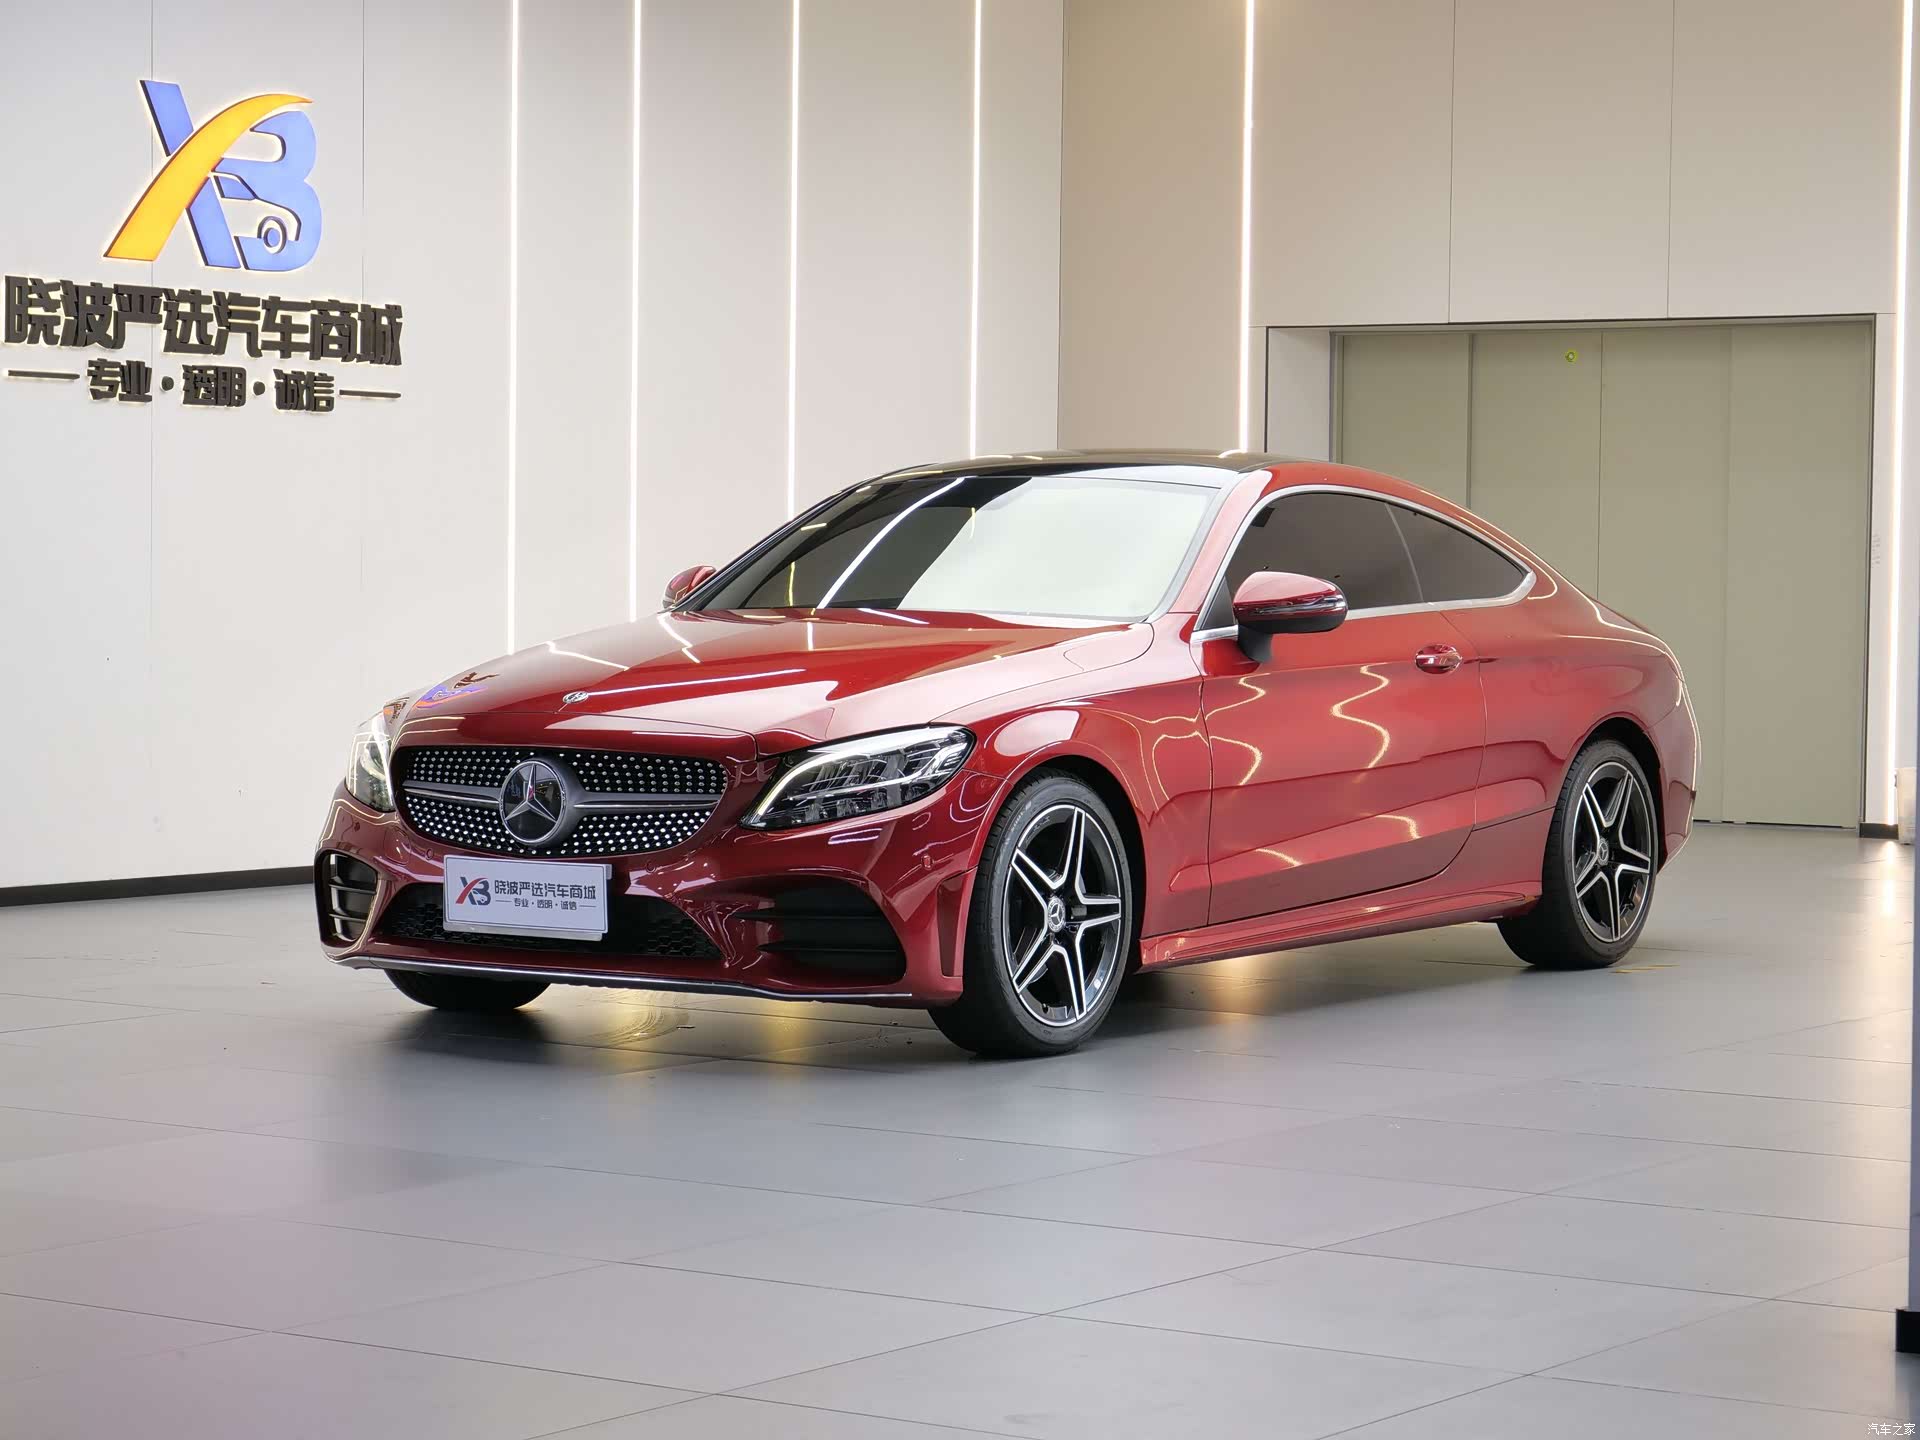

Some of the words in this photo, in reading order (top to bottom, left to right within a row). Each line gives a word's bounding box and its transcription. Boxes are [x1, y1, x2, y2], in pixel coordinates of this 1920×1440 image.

[4, 275, 402, 366] 晓波严选汽车商城
[494, 879, 596, 900] 晓波严选汽车商城
